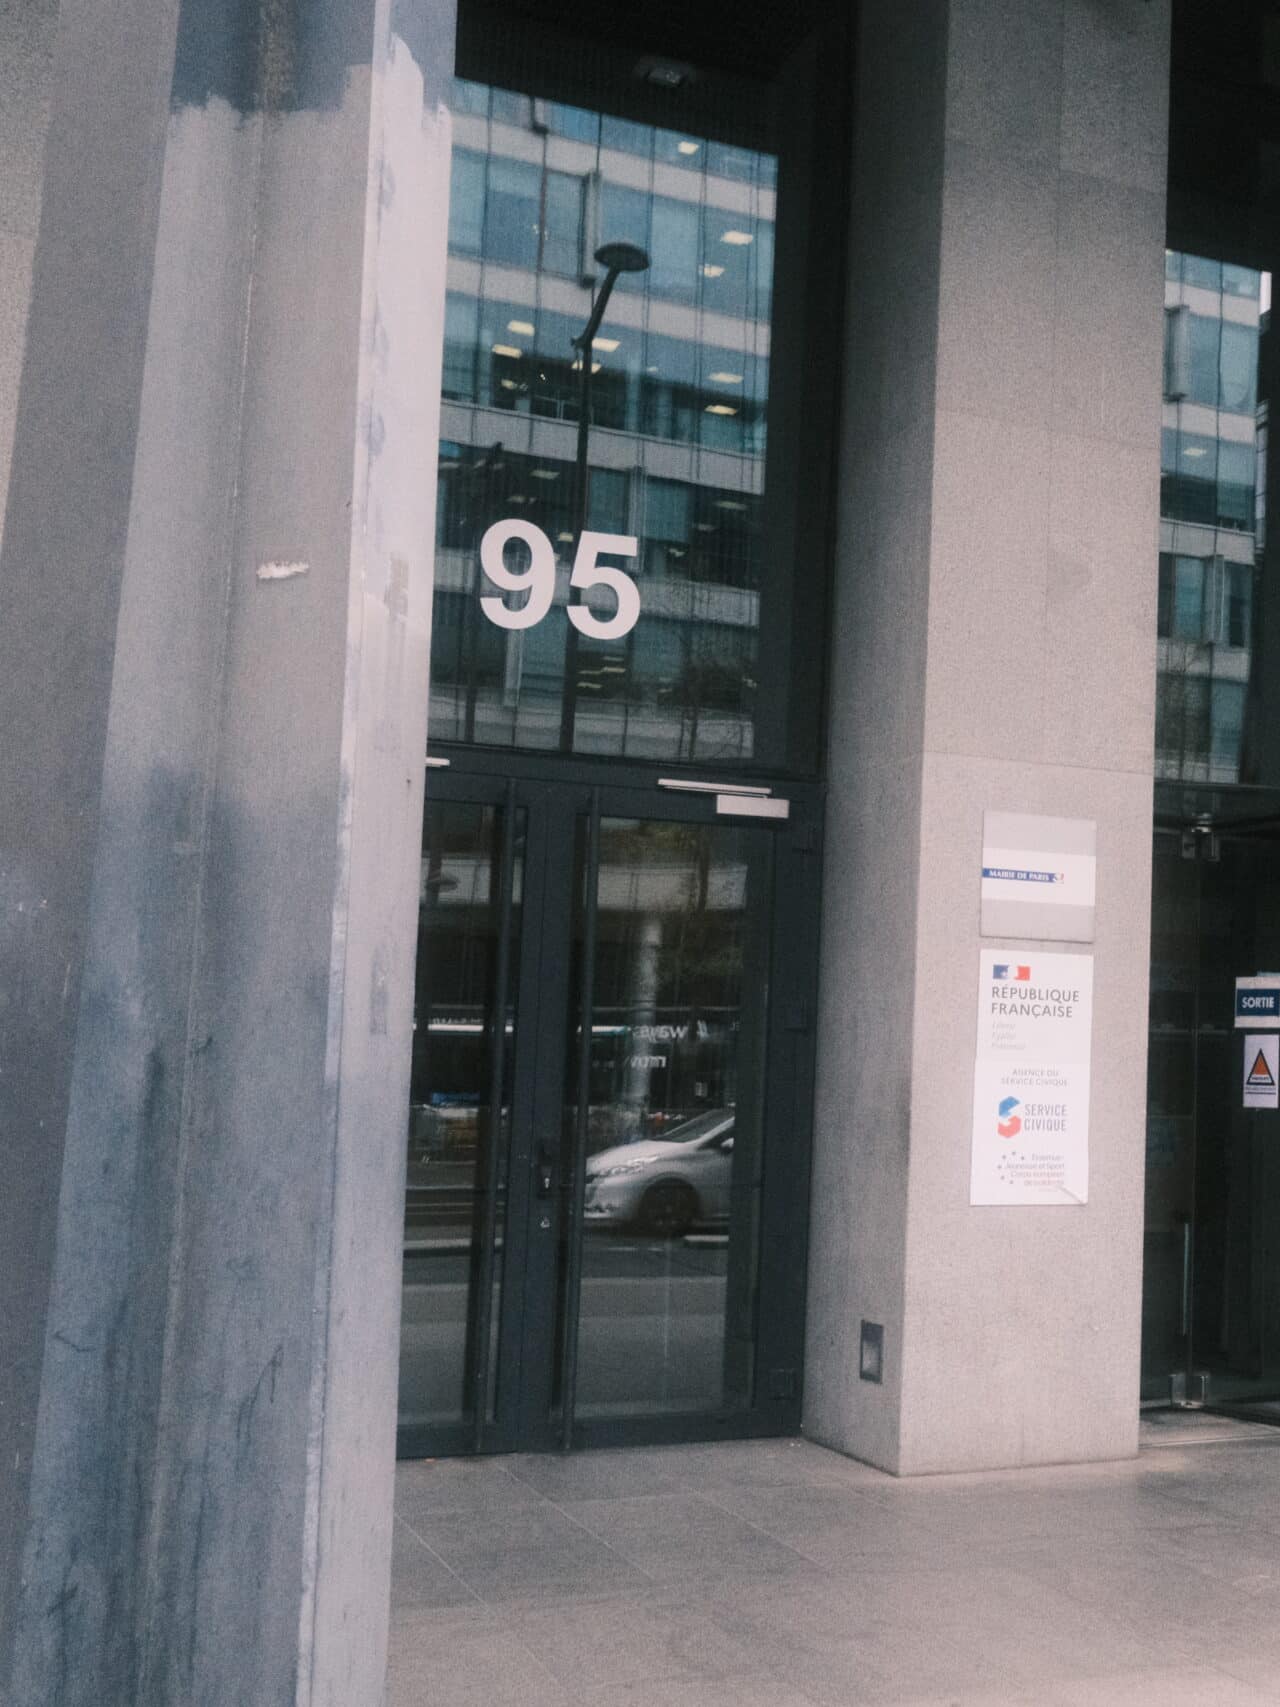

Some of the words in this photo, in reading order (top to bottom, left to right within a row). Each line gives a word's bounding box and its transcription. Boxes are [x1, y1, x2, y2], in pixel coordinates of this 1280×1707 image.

[480, 518, 641, 640] 95
[989, 870, 1015, 880] MAIRIE
[1016, 872, 1027, 881] DE
[1028, 872, 1050, 883] PARIS
[991, 985, 1080, 1004] RÉPUBLIQUE
[1241, 996, 1275, 1009] SORTIE
[991, 1002, 1073, 1019] FRANÇAISE
[1024, 1103, 1068, 1117] SERVICE
[1023, 1118, 1067, 1132] CIVIQUE
